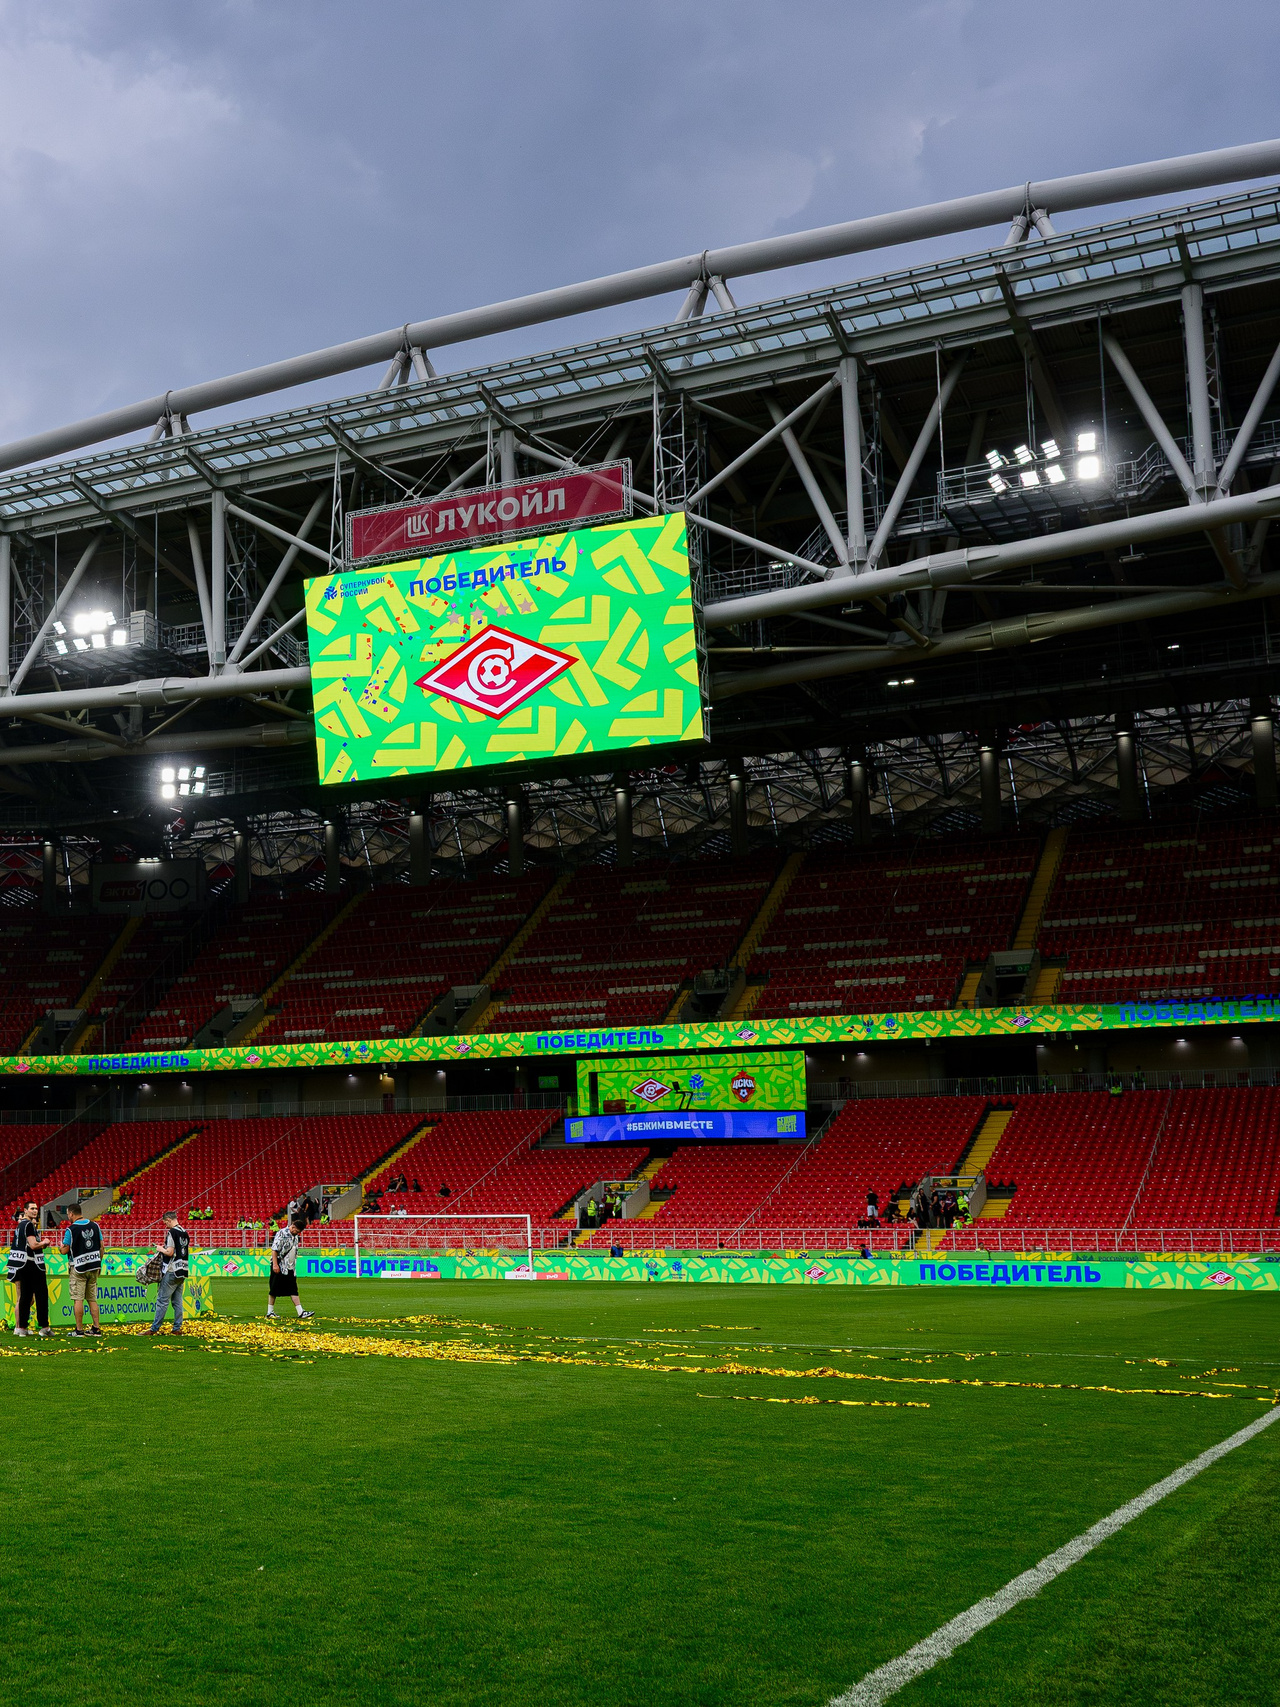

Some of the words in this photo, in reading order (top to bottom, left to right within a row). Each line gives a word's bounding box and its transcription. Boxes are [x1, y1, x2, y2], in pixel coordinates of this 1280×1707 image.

[434, 487, 566, 534] ЛУКОЙЛ
[339, 577, 385, 592] СУПЕРКУБОК
[409, 556, 567, 598] ПОБЕДИТЕЛЬ
[340, 588, 368, 599] РОССИИ
[104, 887, 136, 896] ЭКТО
[537, 1031, 664, 1050] ПОБЕДИТЕЛЬ
[88, 1055, 190, 1071] ПОБЕДИТЕЛЬ
[732, 1078, 755, 1090] ЦСКА
[626, 1120, 714, 1132] #БЕЖИМВМЕСТЕ
[306, 1258, 439, 1278] ПОБЕДИТЕЛЬ
[919, 1263, 1102, 1285] ПОБЕДИТЕЛЬ
[96, 1286, 147, 1301] ЛАДАТЕЛЬ
[116, 1302, 150, 1314] РОССИИ
